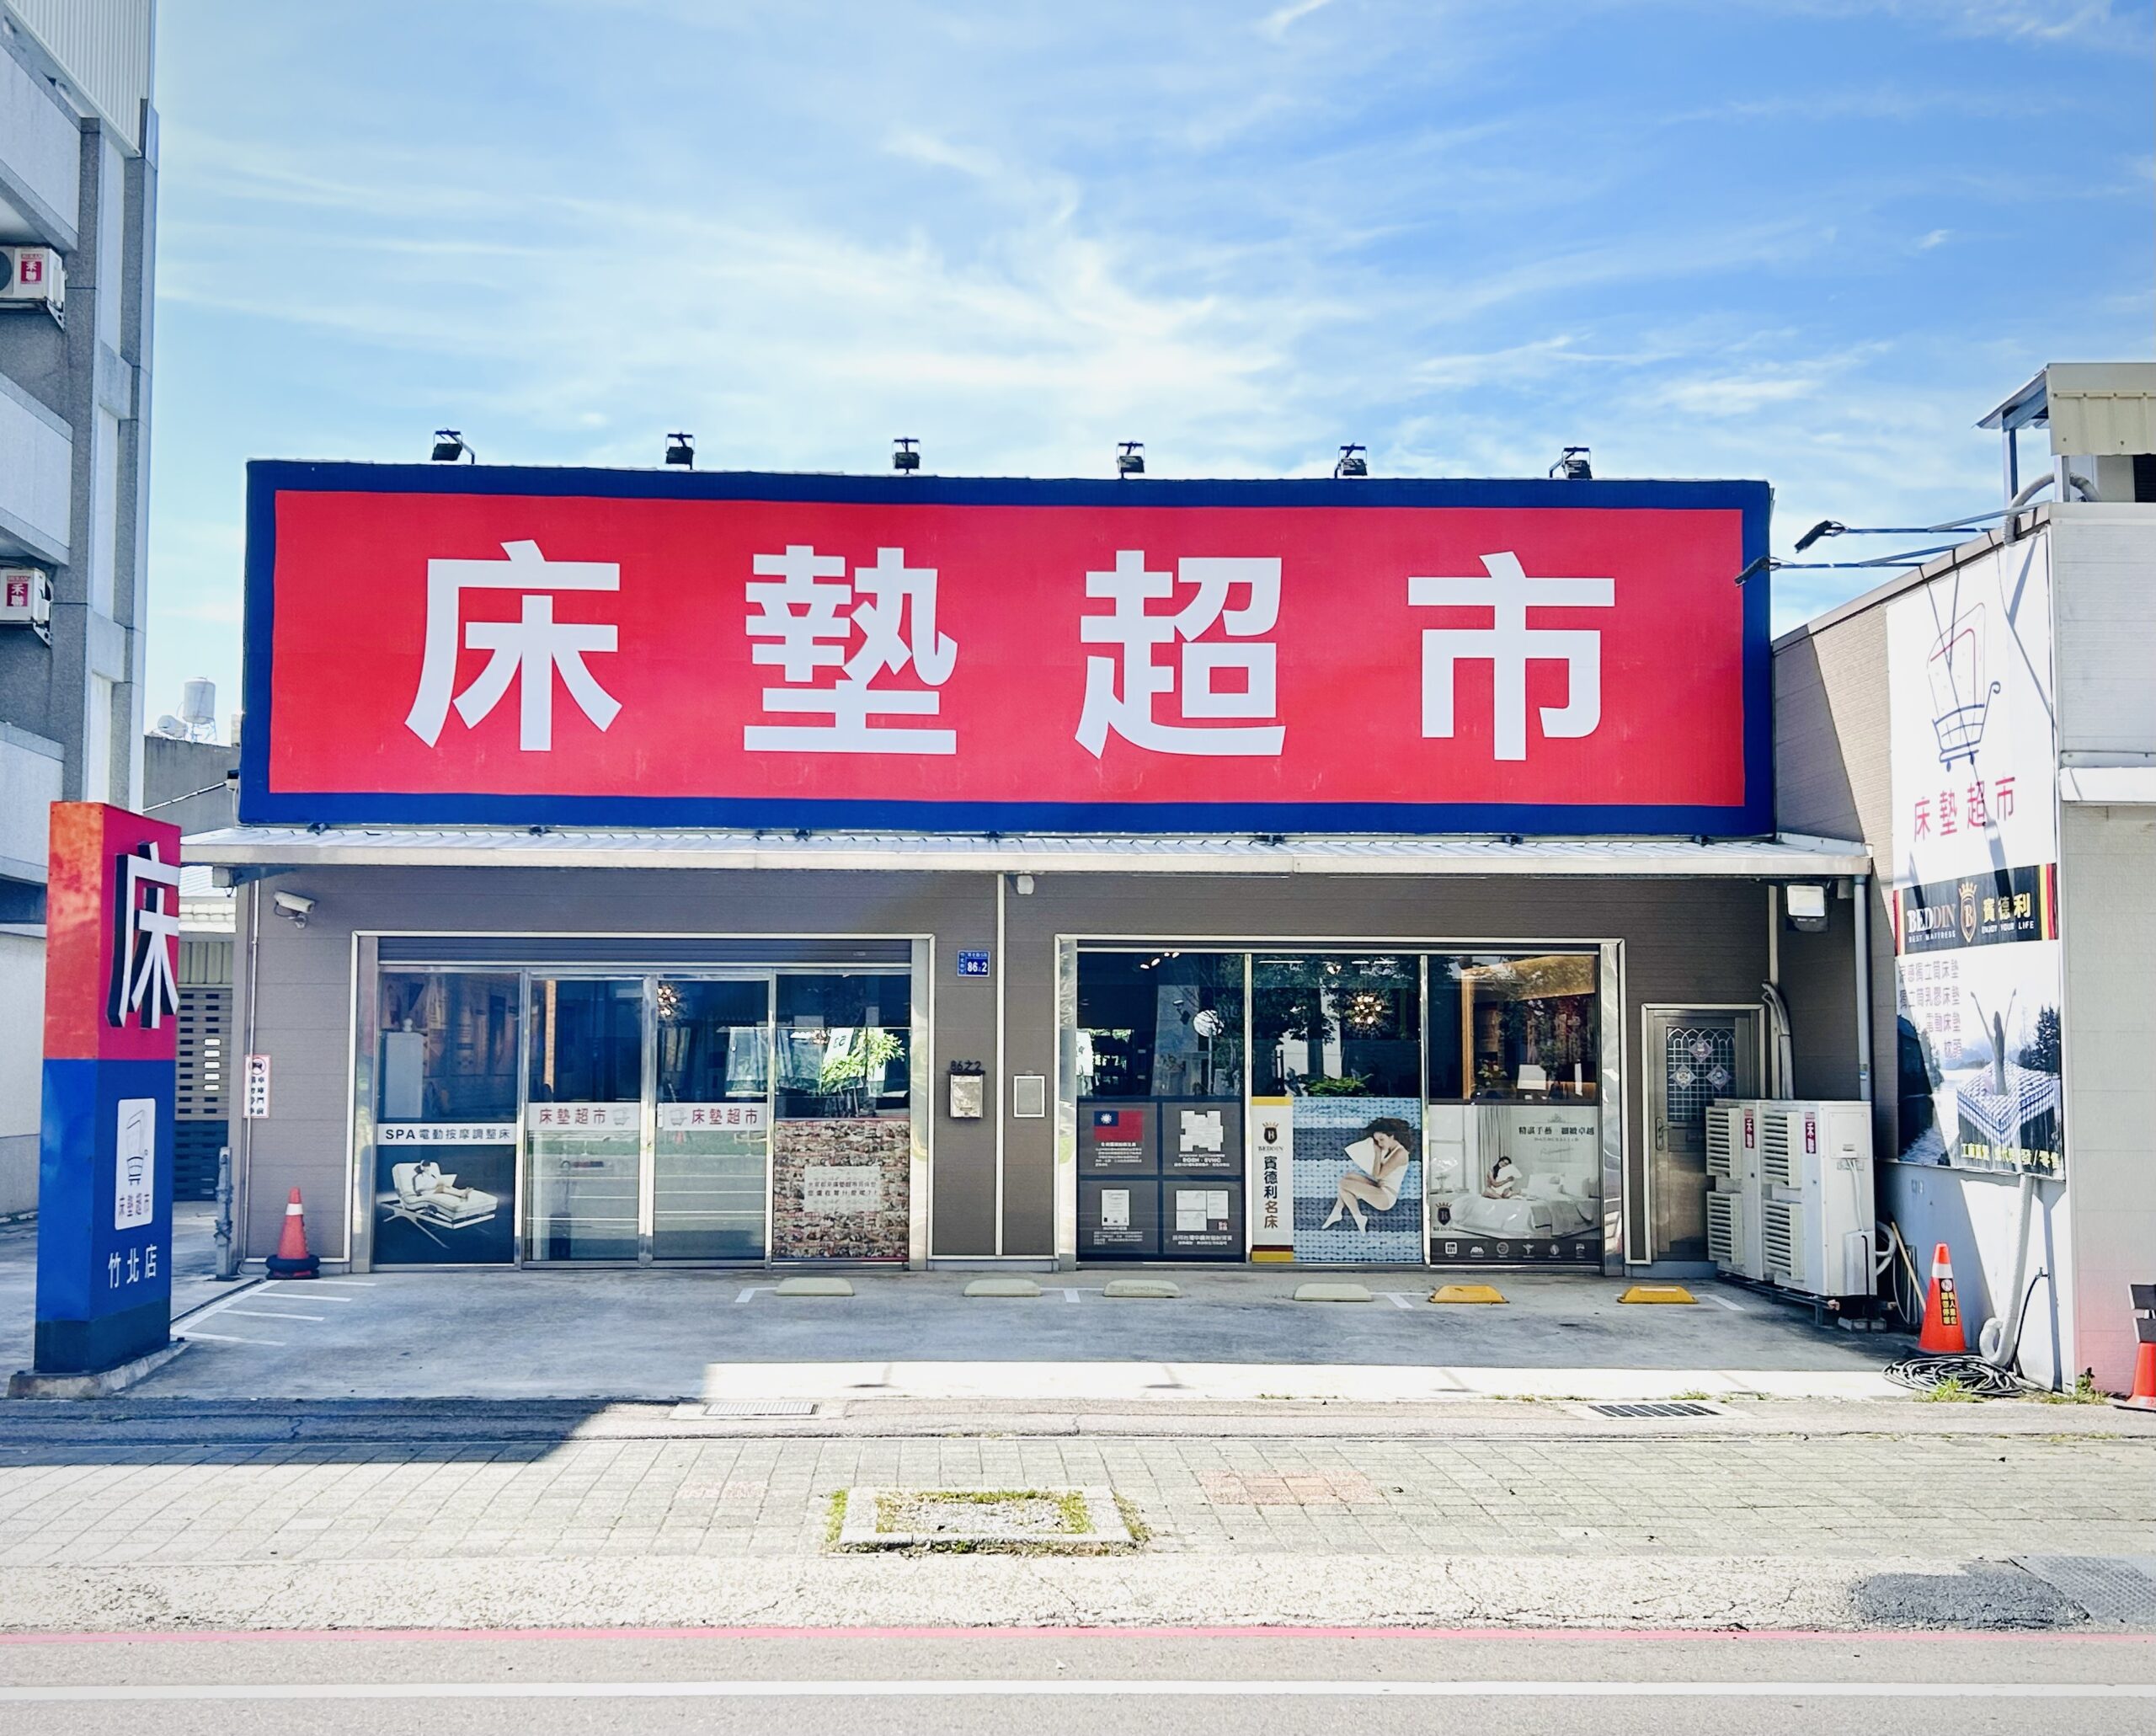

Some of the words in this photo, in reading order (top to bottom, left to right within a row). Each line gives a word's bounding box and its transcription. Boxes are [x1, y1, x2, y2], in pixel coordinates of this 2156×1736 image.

[405, 539, 1615, 762] 床墊超市
[1913, 772, 2016, 843] 床墊超市
[1906, 903, 1956, 933] BEDDIN
[1983, 892, 2031, 924] 賓德利
[2018, 920, 2035, 930] LIFE
[109, 841, 180, 1029] 床
[539, 1108, 606, 1125] 床墊超市
[691, 1108, 759, 1125] 床墊超市
[1263, 1156, 1278, 1229] 賓德利名床
[108, 1244, 157, 1290] 竹北店
